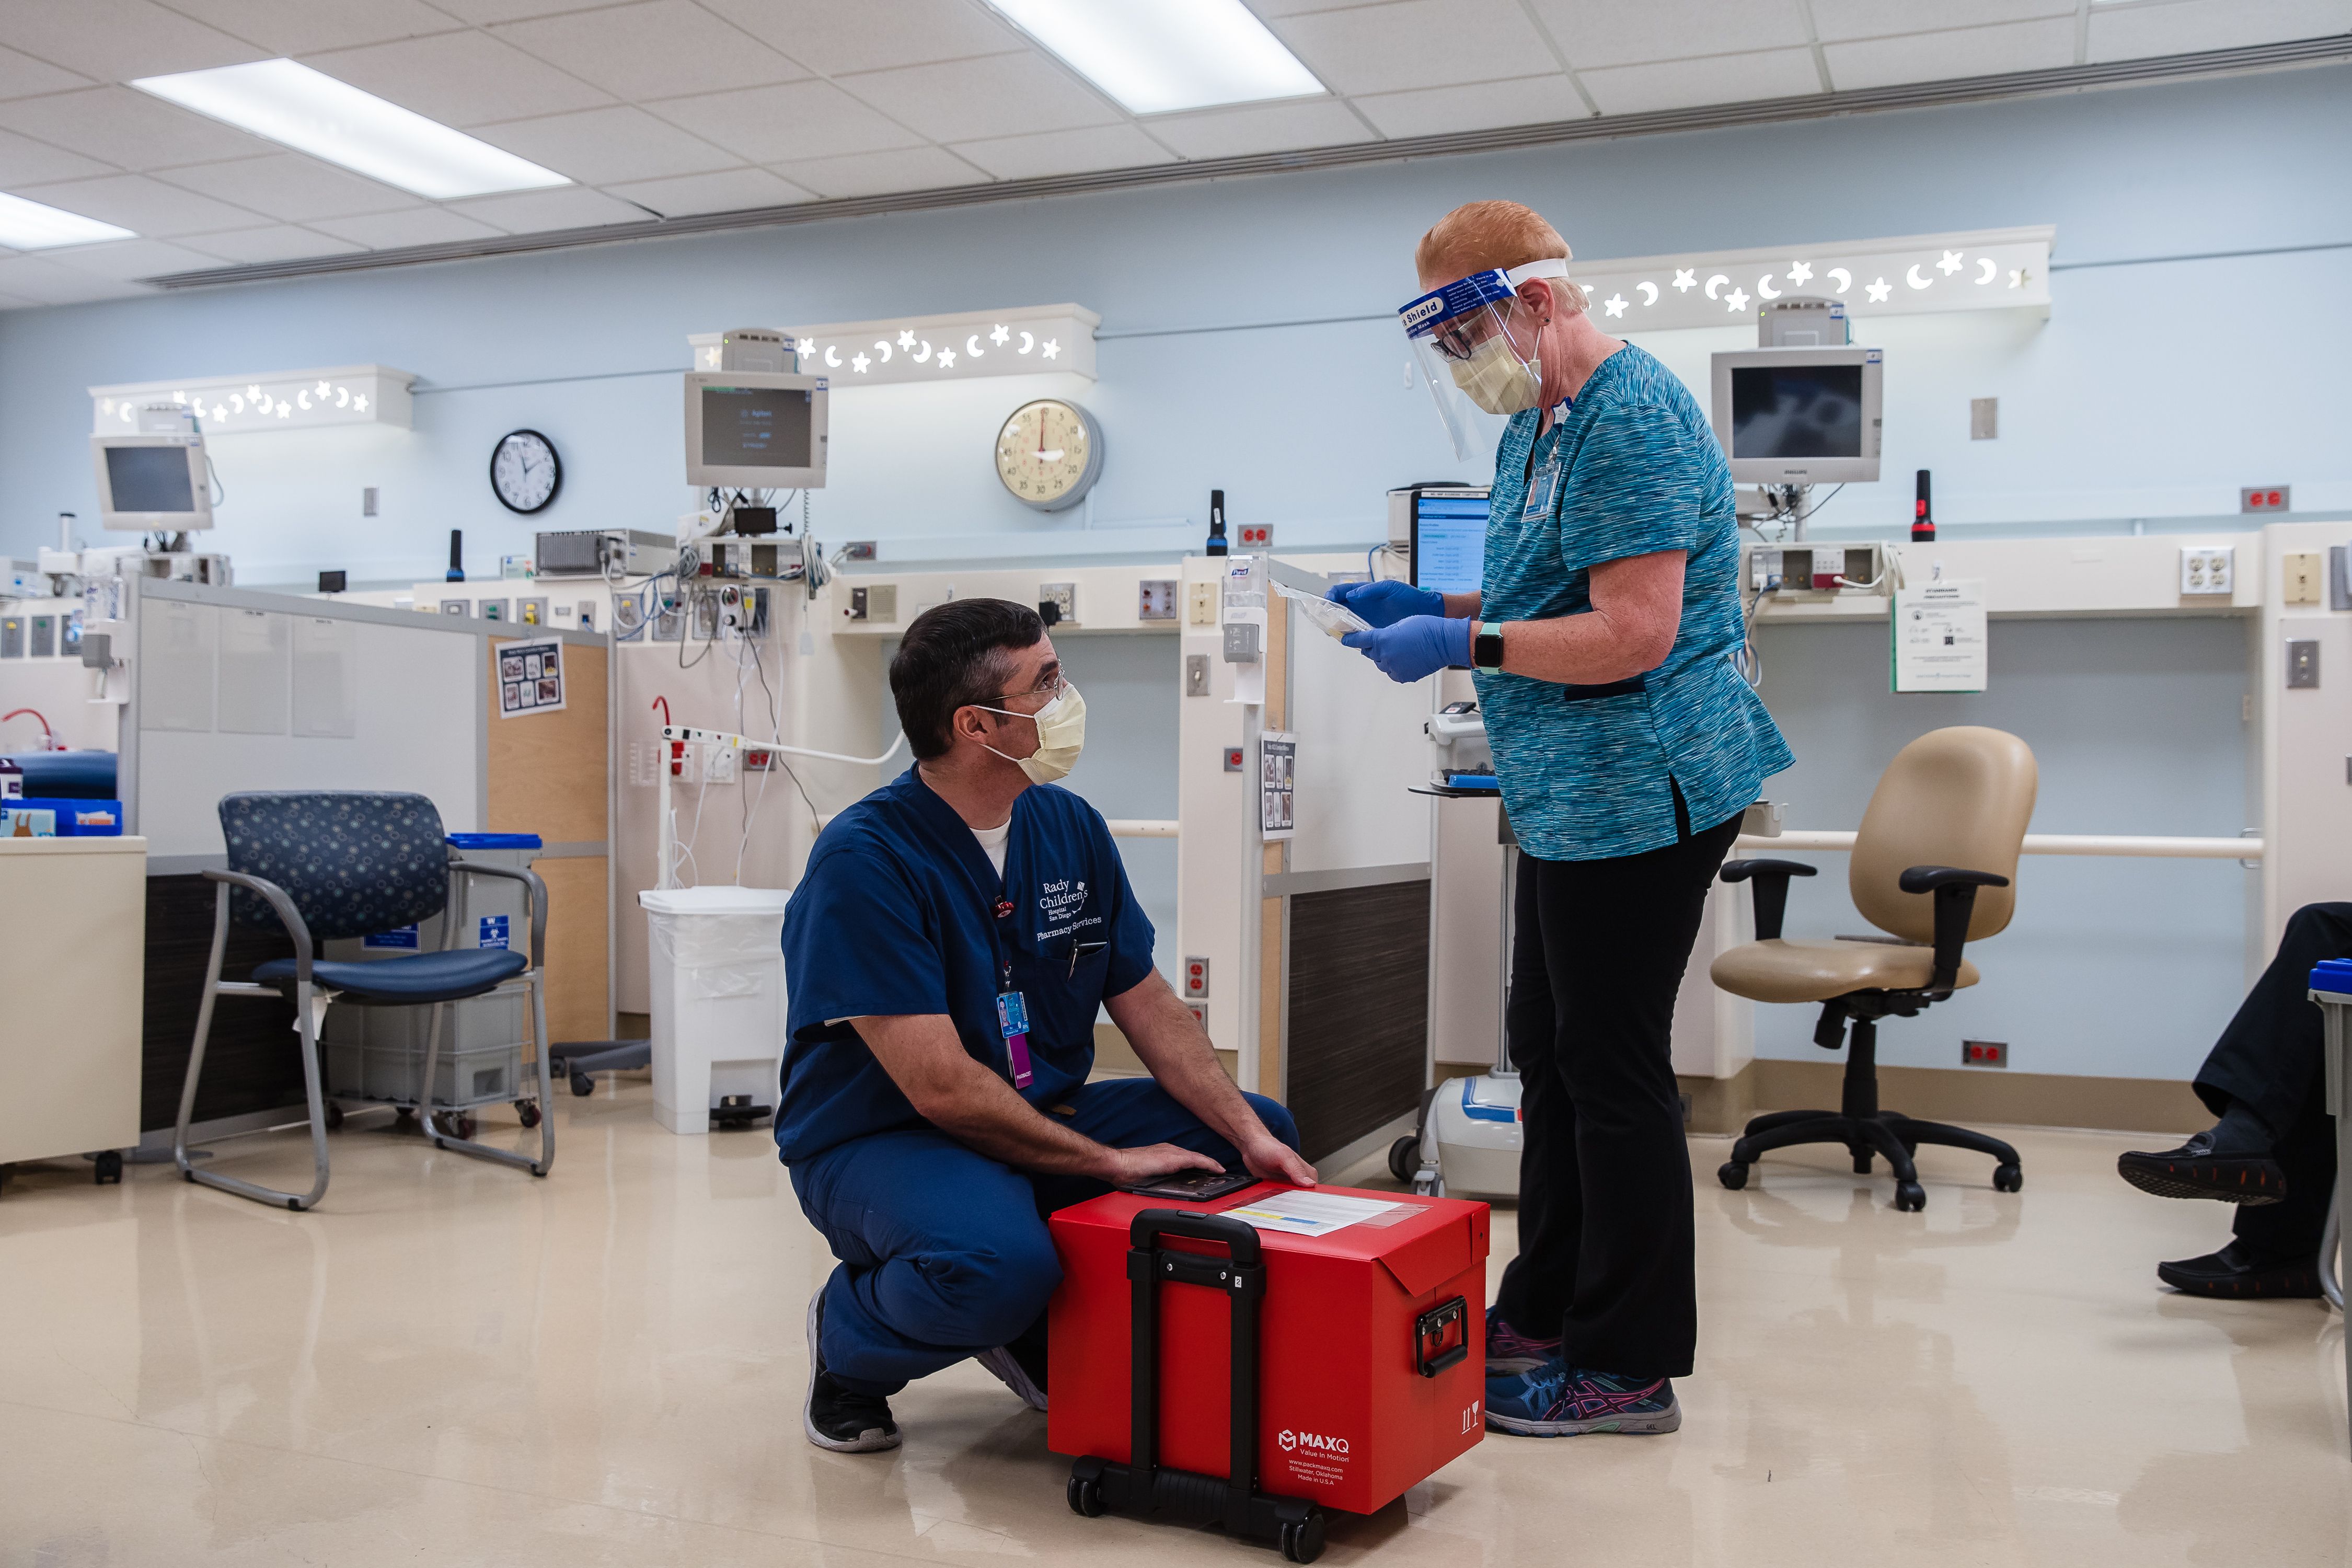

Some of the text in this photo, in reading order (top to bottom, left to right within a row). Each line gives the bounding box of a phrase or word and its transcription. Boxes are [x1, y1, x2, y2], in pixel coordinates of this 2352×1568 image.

[1406, 301, 1438, 324] Shield
[1417, 321, 1430, 329] Mask
[1043, 879, 1069, 894] Rady
[1048, 906, 1067, 915] Hospital
[1037, 917, 1102, 941] Pharmacy Services
[1300, 1432, 1348, 1454] MAXQ
[1300, 1448, 1318, 1457] Value
[1289, 1459, 1343, 1473] www.packmaxq.com
[1289, 1466, 1343, 1480] Stillwater, Oklahoma
